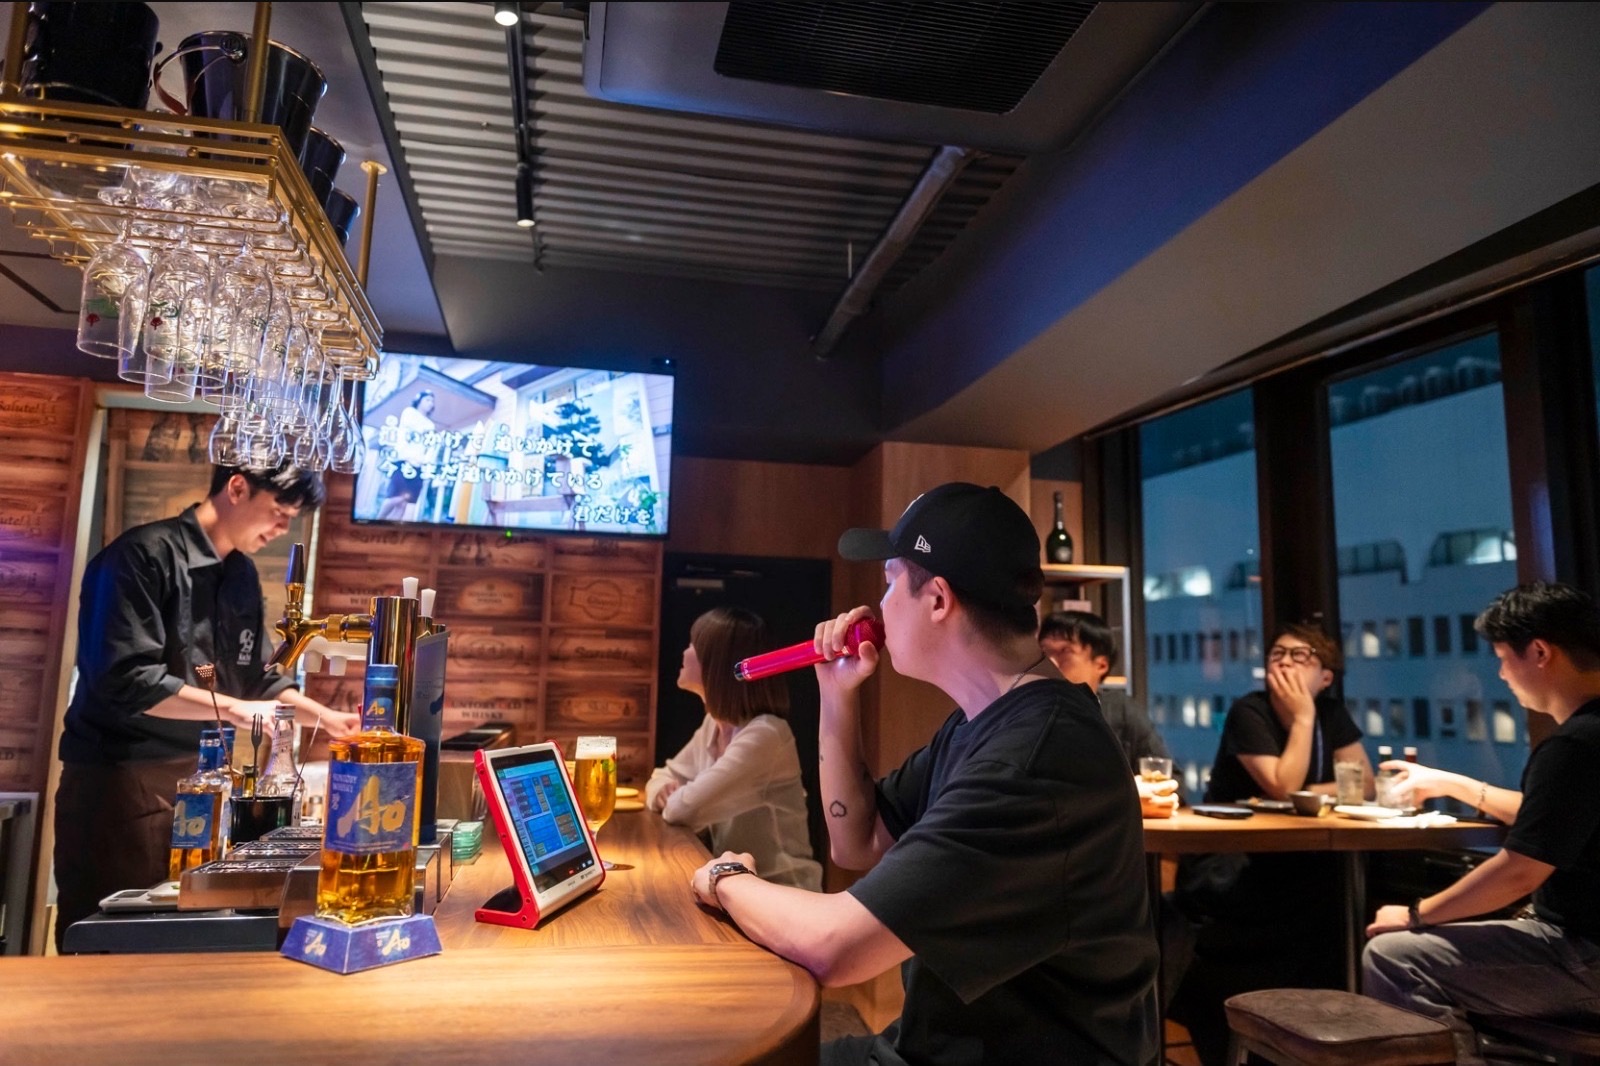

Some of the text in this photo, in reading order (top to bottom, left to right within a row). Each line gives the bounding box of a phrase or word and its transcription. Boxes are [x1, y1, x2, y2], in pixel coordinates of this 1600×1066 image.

[494, 434, 594, 457] 追いかけて
[377, 460, 602, 489] 今もまだ追いかけている
[574, 505, 650, 525] 君だけを
[366, 700, 385, 716] Ao
[337, 775, 406, 838] Ao
[381, 928, 411, 956] Ao
